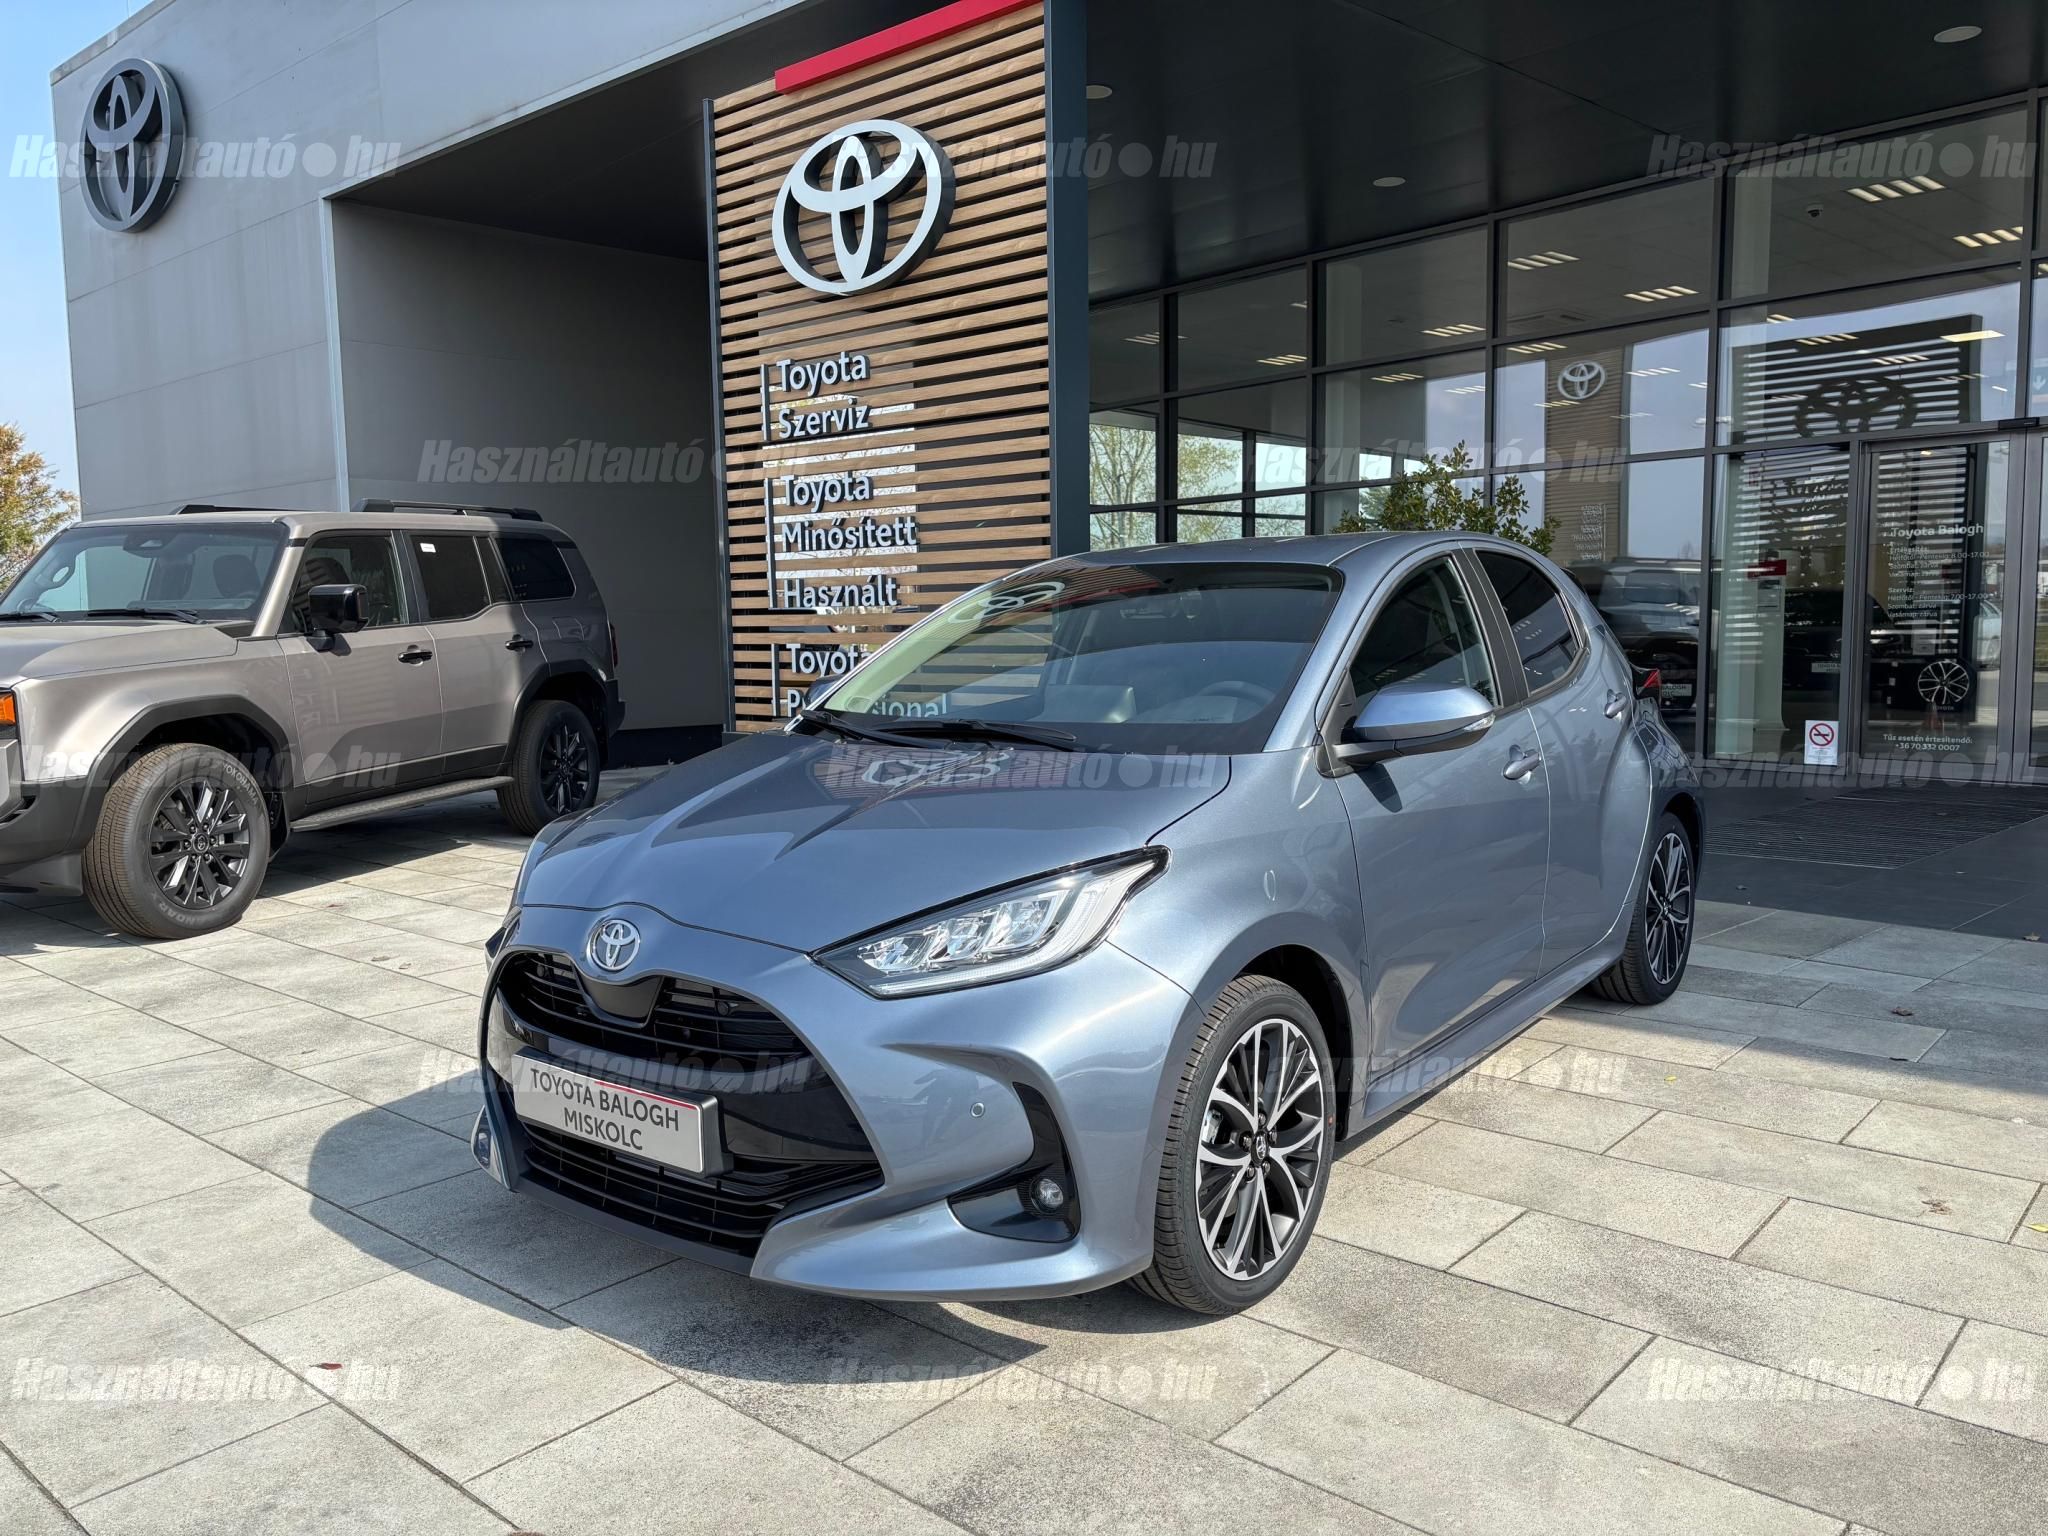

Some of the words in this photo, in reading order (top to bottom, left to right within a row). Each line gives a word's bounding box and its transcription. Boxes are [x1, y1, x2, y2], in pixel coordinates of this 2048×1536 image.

[776, 351, 870, 396] Toyota
[778, 398, 871, 439] Szerviz
[781, 473, 873, 512] Toyota
[781, 515, 918, 552] Minősített
[1890, 526, 1935, 539] Toyota
[784, 573, 898, 609] Használt
[530, 1068, 594, 1107] TOYOTA
[599, 1090, 679, 1131] BALOGH
[563, 1108, 643, 1150] MISKOLC
